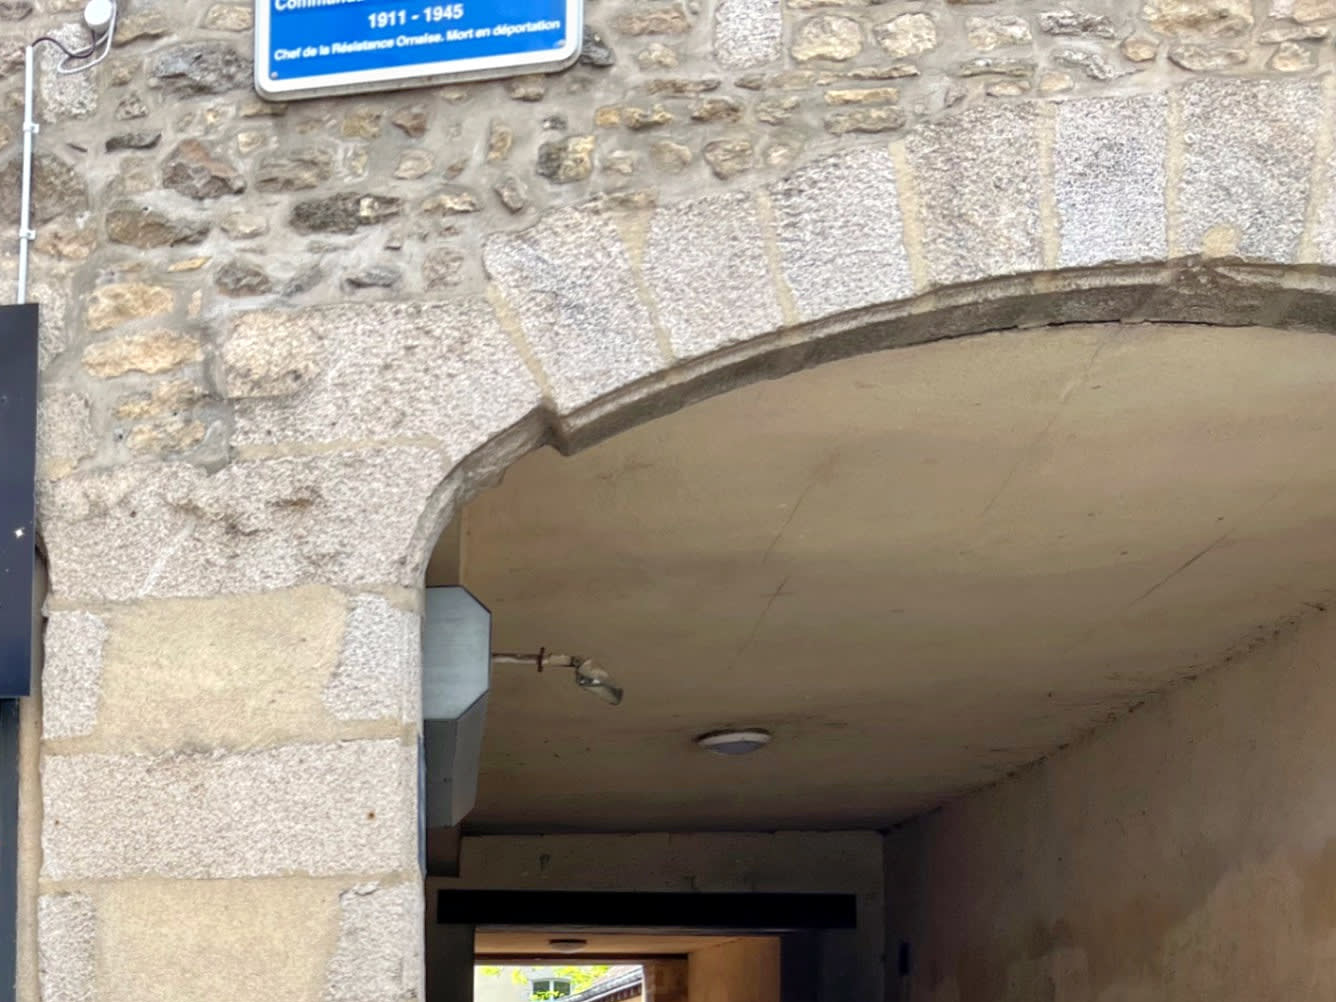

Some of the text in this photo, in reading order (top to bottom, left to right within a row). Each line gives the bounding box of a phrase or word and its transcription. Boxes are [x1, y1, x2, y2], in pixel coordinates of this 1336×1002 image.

[368, 9, 406, 29] 1911
[424, 3, 463, 23] 1945
[274, 47, 302, 61] Chef
[302, 45, 318, 58] de
[319, 44, 330, 56] la
[331, 38, 395, 55] Résistance
[446, 28, 474, 42] Mort
[475, 27, 491, 39] en
[492, 20, 561, 38] déportation
